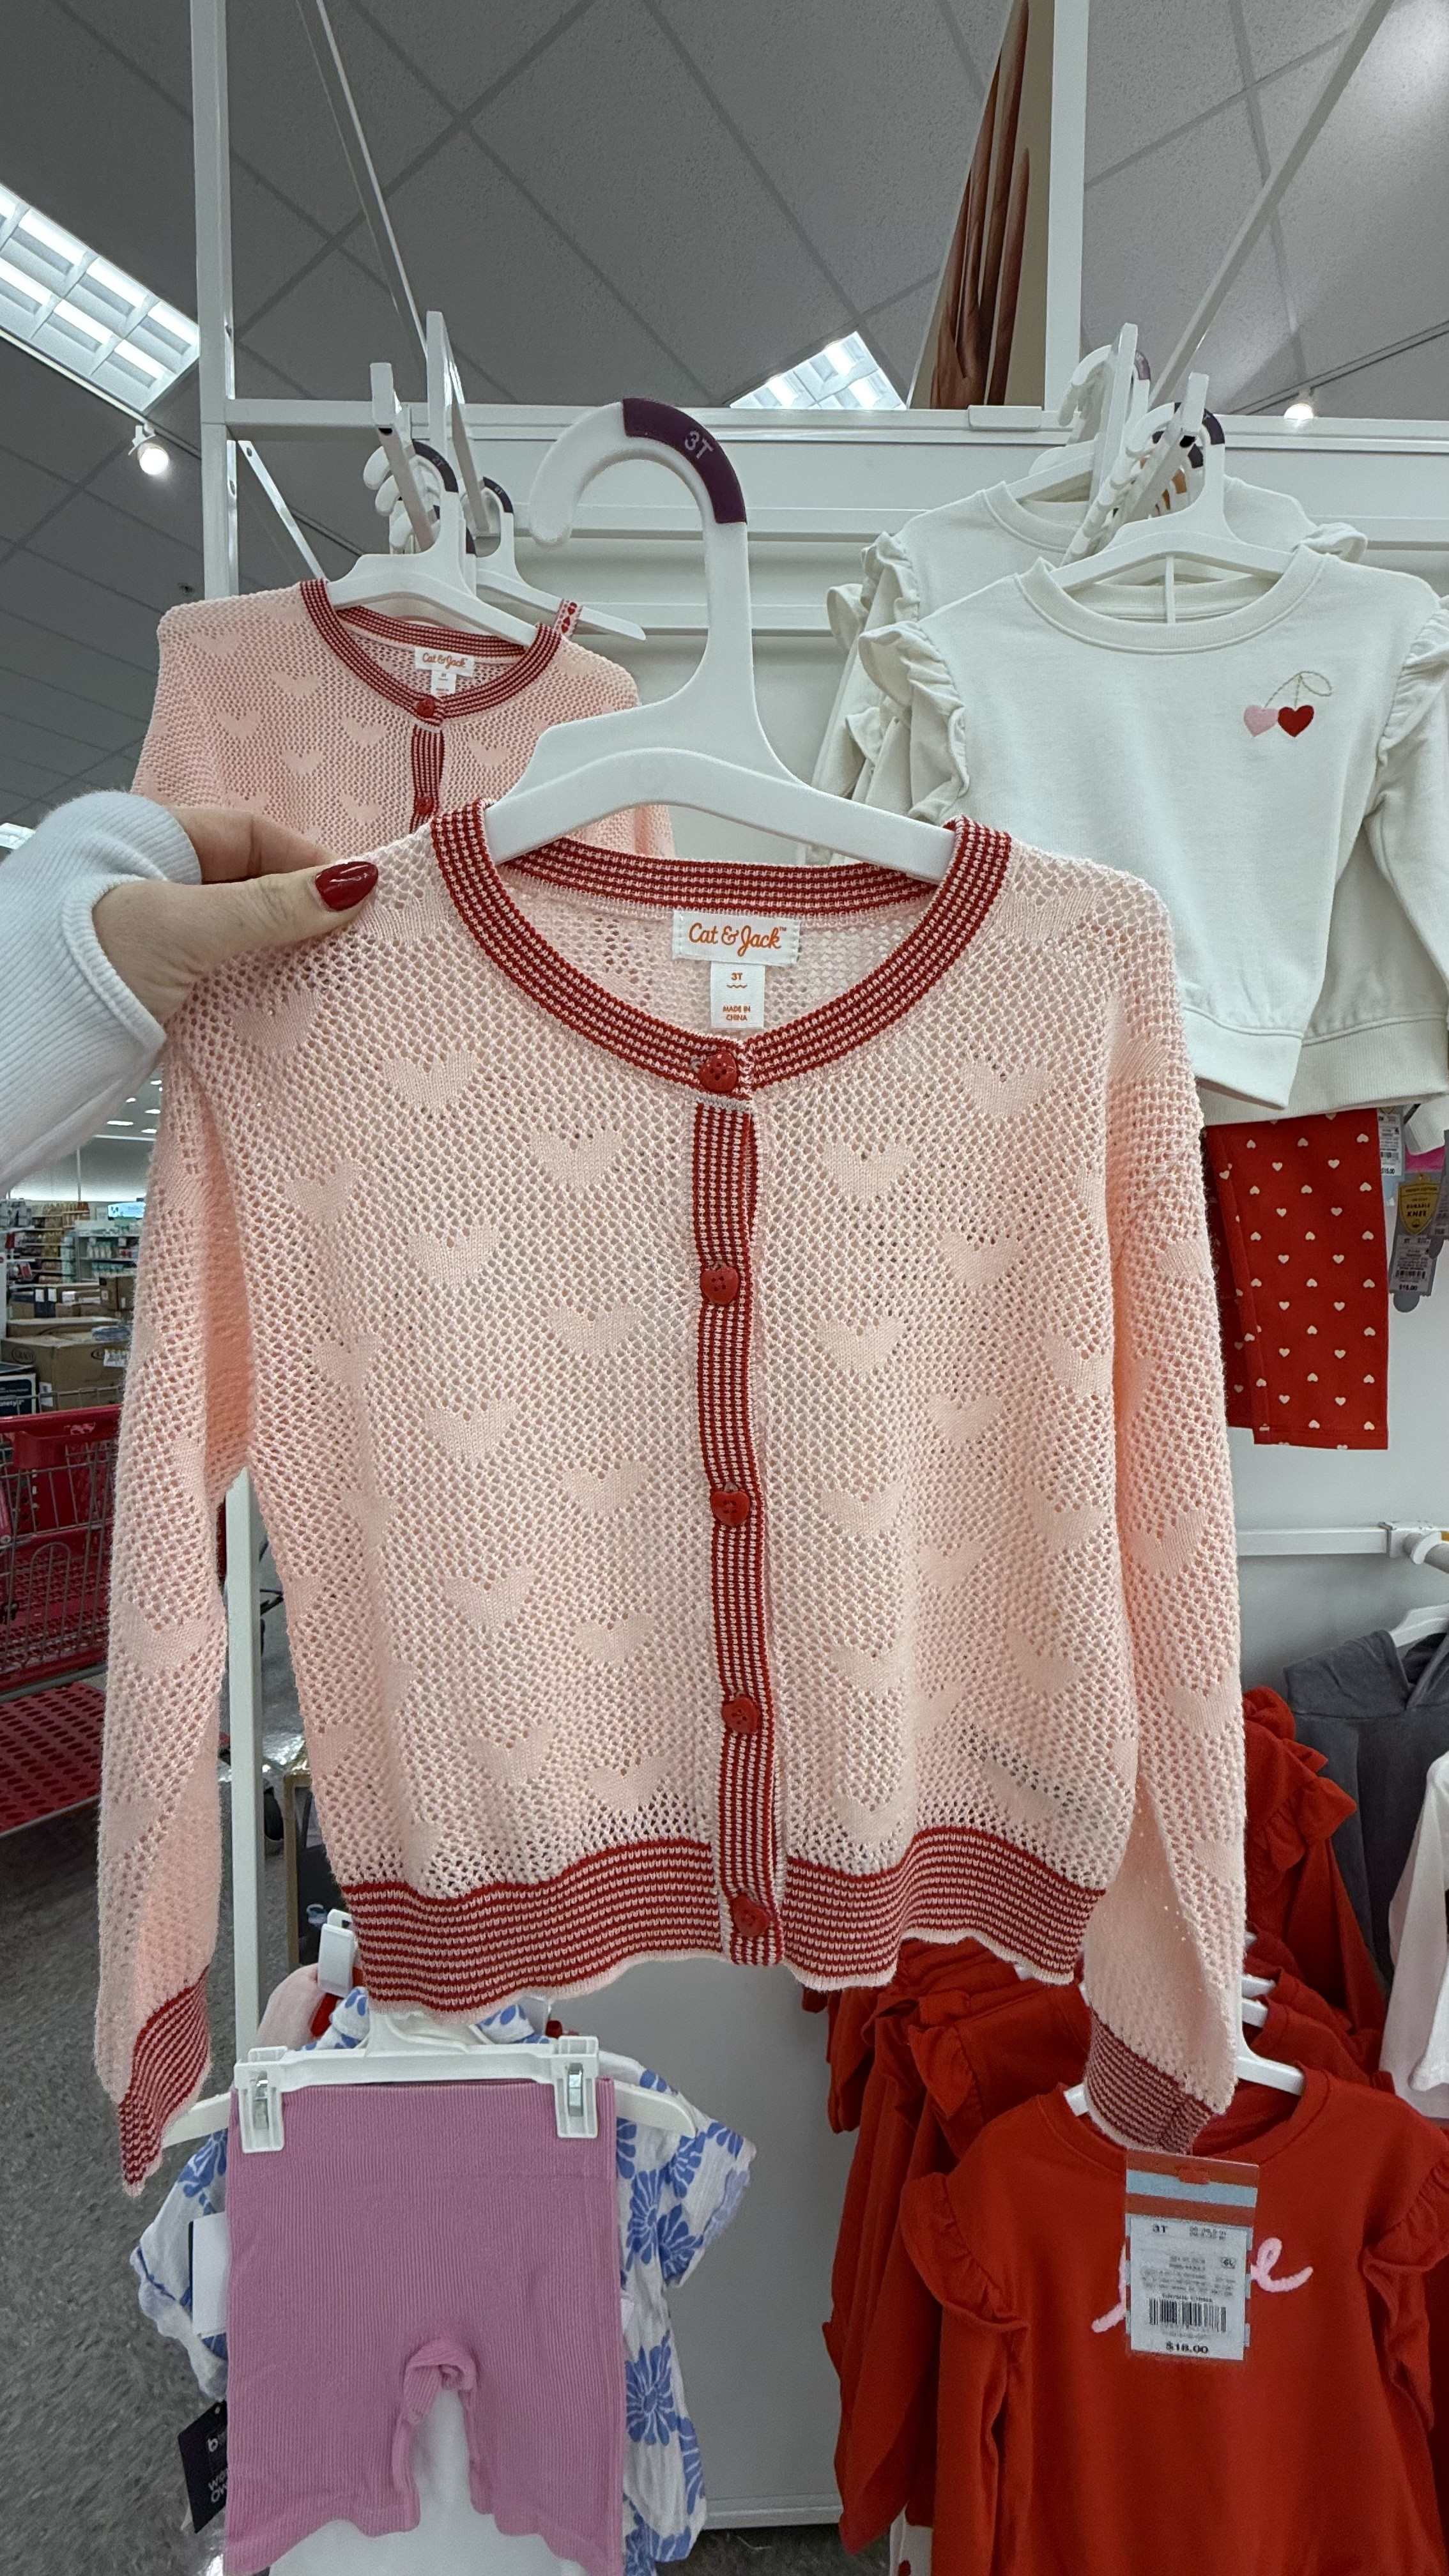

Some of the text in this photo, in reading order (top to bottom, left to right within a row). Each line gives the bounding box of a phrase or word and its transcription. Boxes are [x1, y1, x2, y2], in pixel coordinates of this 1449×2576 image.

[684, 431, 714, 459] 3T
[422, 652, 436, 663] Cat
[689, 923, 719, 944] Cat
[721, 925, 739, 946] &
[731, 972, 743, 981] 3T
[723, 1005, 751, 1013] MADE IN
[1152, 2224, 1168, 2234] 3T
[1165, 2340, 1209, 2354] $18.00
